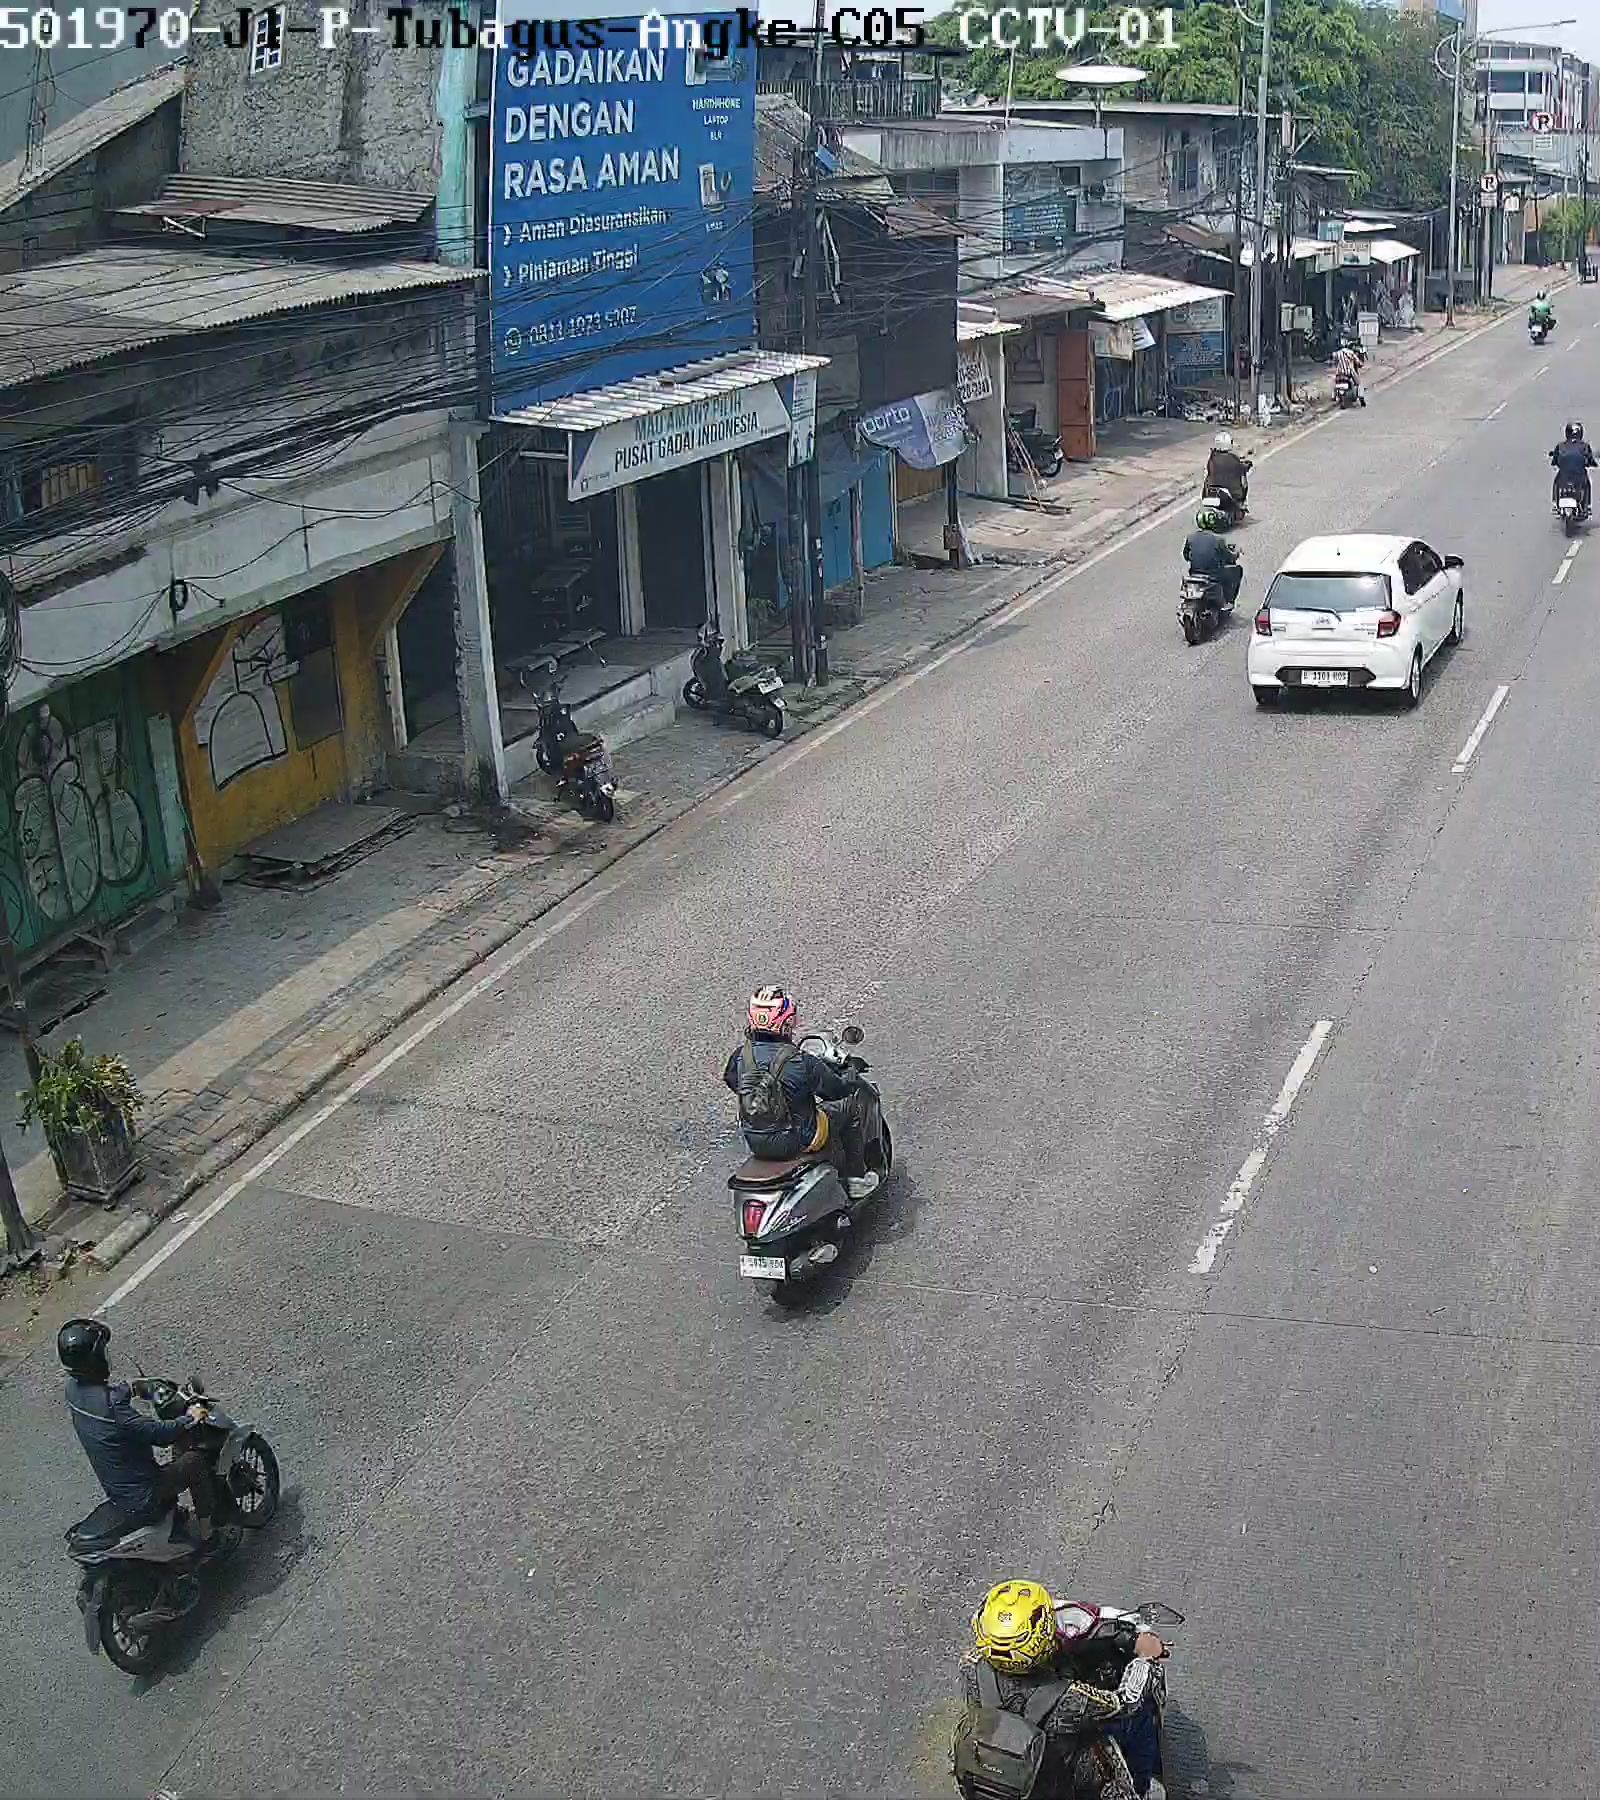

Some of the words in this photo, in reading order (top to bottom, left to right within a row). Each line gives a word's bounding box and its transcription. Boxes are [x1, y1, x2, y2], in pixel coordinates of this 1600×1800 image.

[507, 48, 665, 88] GADAIKAN
[505, 100, 634, 143] DENGAN
[504, 156, 588, 199] RASA
[597, 146, 680, 190] AMAN
[520, 220, 565, 242] Aman
[569, 205, 667, 235] Diasuransikan
[592, 244, 639, 272] Tinggi
[614, 441, 654, 473] PUSAT
[658, 430, 695, 459] GADAI
[697, 411, 759, 449] INDONESIA
[635, 415, 664, 440] MAU
